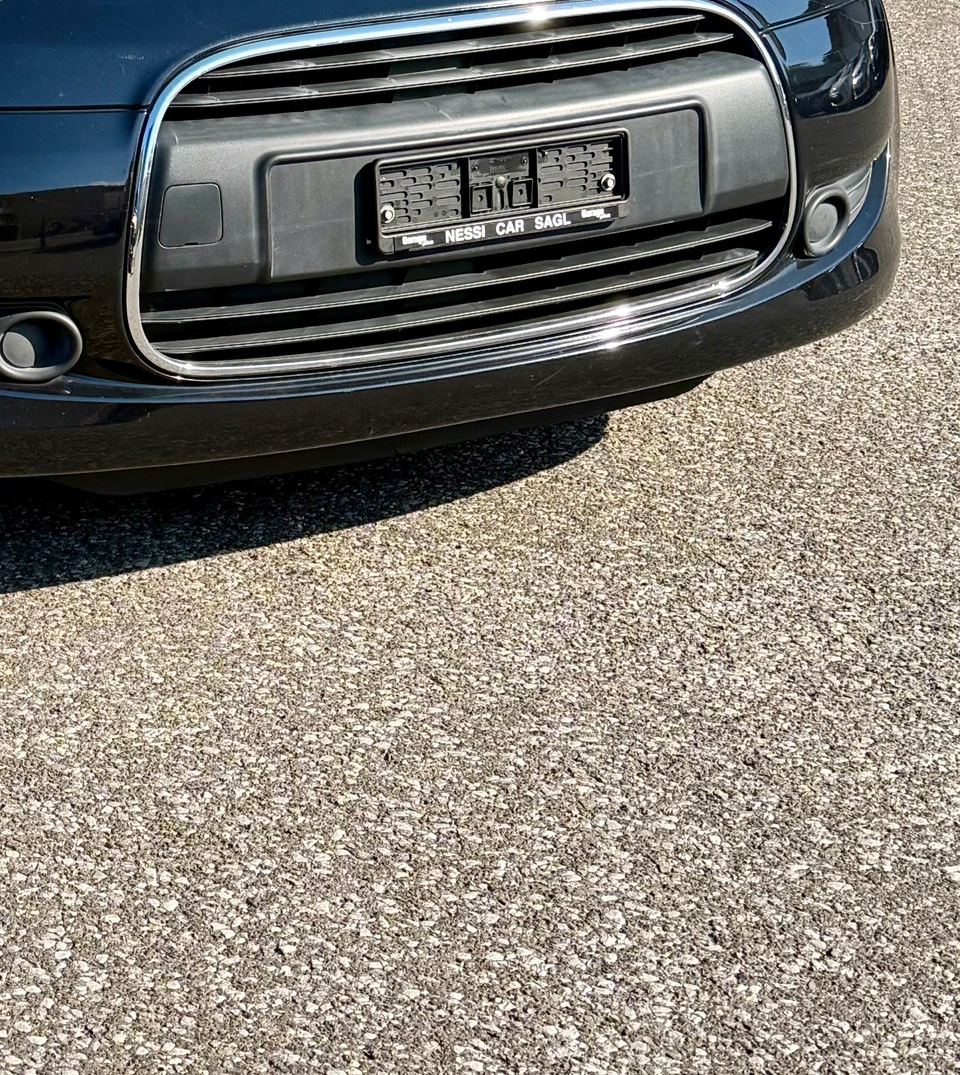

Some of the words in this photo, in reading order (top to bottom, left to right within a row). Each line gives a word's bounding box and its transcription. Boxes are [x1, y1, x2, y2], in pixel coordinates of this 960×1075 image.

[445, 225, 486, 243] NESSI
[496, 219, 525, 236] CAR
[535, 212, 571, 229] SAGL
